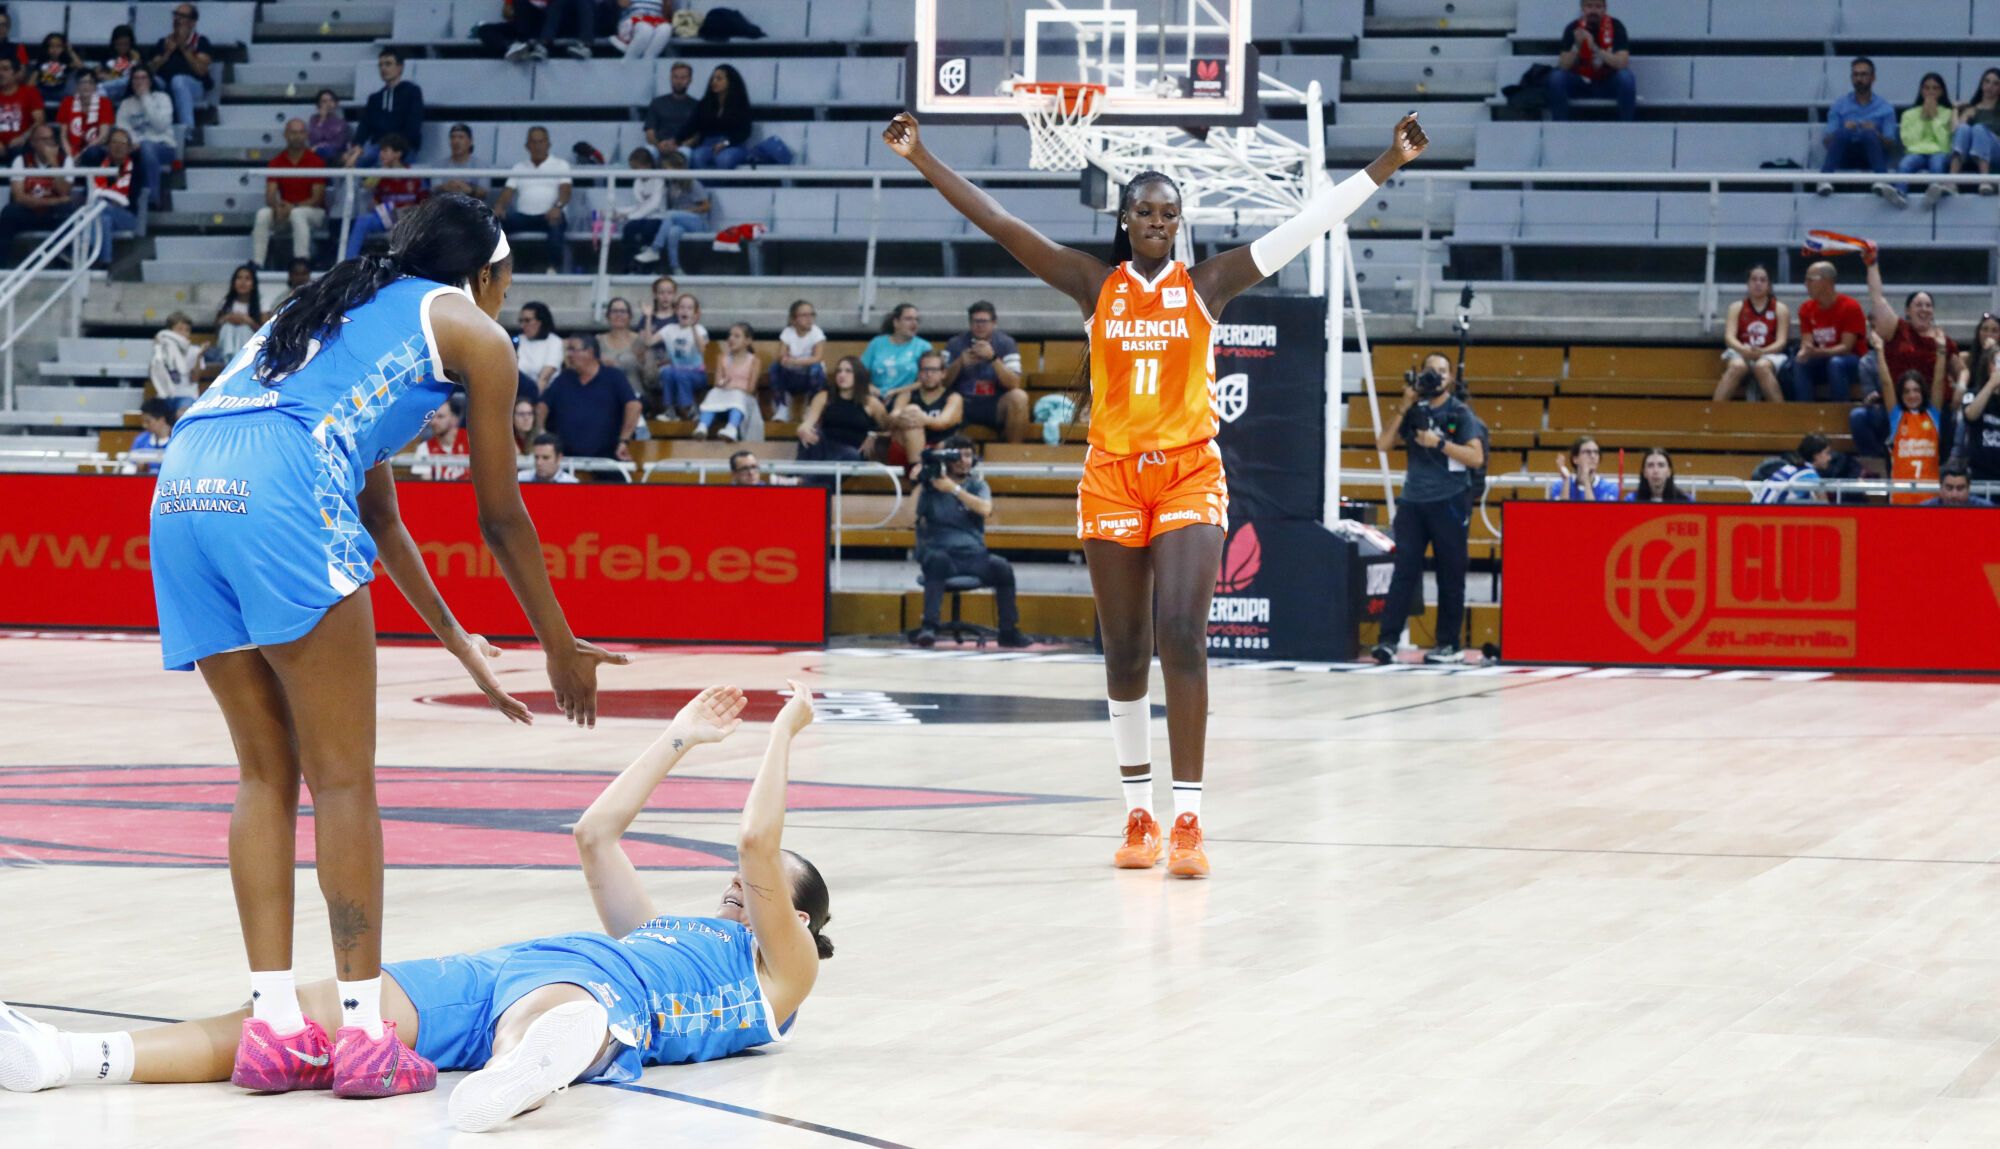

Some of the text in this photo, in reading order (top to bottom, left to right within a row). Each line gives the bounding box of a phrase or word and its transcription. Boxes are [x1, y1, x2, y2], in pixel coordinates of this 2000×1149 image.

[1105, 318, 1190, 339] VALENCIA
[1214, 324, 1277, 347] PERCOPA
[1121, 340, 1169, 352] BASKET
[1134, 358, 1159, 395] 11
[1910, 460, 1923, 479] 7
[161, 478, 250, 499] CAJA RURAL
[159, 498, 248, 515] DE SALAMANCA
[1100, 518, 1140, 530] PULEVA
[1666, 521, 1699, 537] FEB
[1730, 522, 1842, 604] CLUB
[1208, 597, 1271, 623] ERCOPA
[636, 918, 681, 931] STILLA
